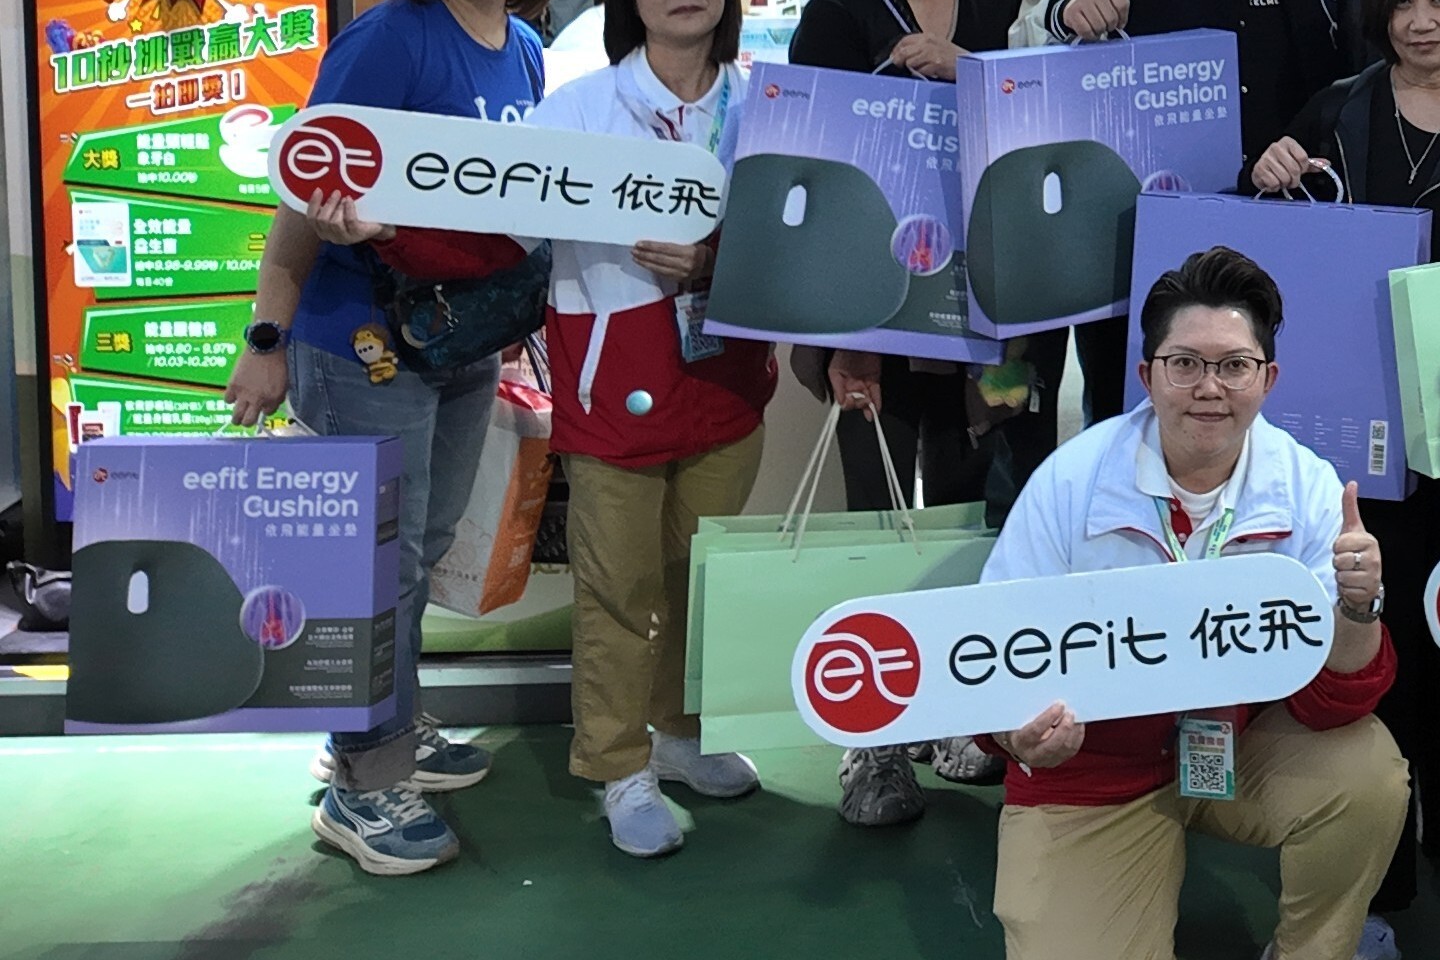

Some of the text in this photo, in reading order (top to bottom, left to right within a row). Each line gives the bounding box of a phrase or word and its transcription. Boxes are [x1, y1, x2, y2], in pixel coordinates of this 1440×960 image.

[1081, 58, 1226, 91] eefit Energy
[851, 95, 918, 124] eefit
[1134, 82, 1228, 113] Cushion
[406, 152, 721, 218] eefit 依飛
[182, 467, 359, 494] eefit Energy
[243, 494, 359, 518] Cushion
[949, 599, 1323, 686] eefit 依飛
